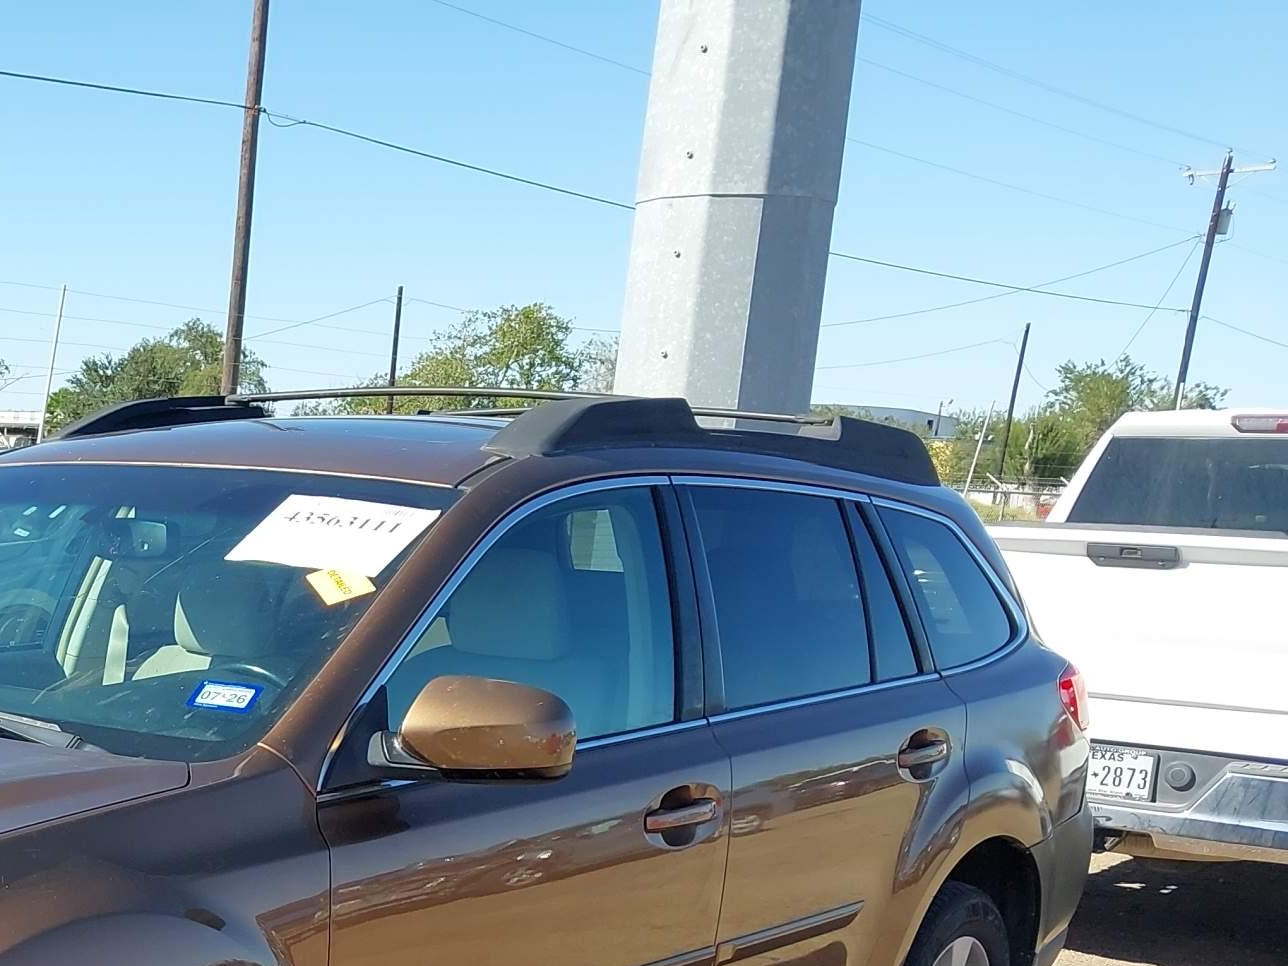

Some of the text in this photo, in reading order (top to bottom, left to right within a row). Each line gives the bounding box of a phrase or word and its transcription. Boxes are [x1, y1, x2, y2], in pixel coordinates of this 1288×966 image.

[284, 511, 402, 533] 43563111
[1089, 750, 1125, 762] EXAS
[1100, 765, 1148, 789] 2873
